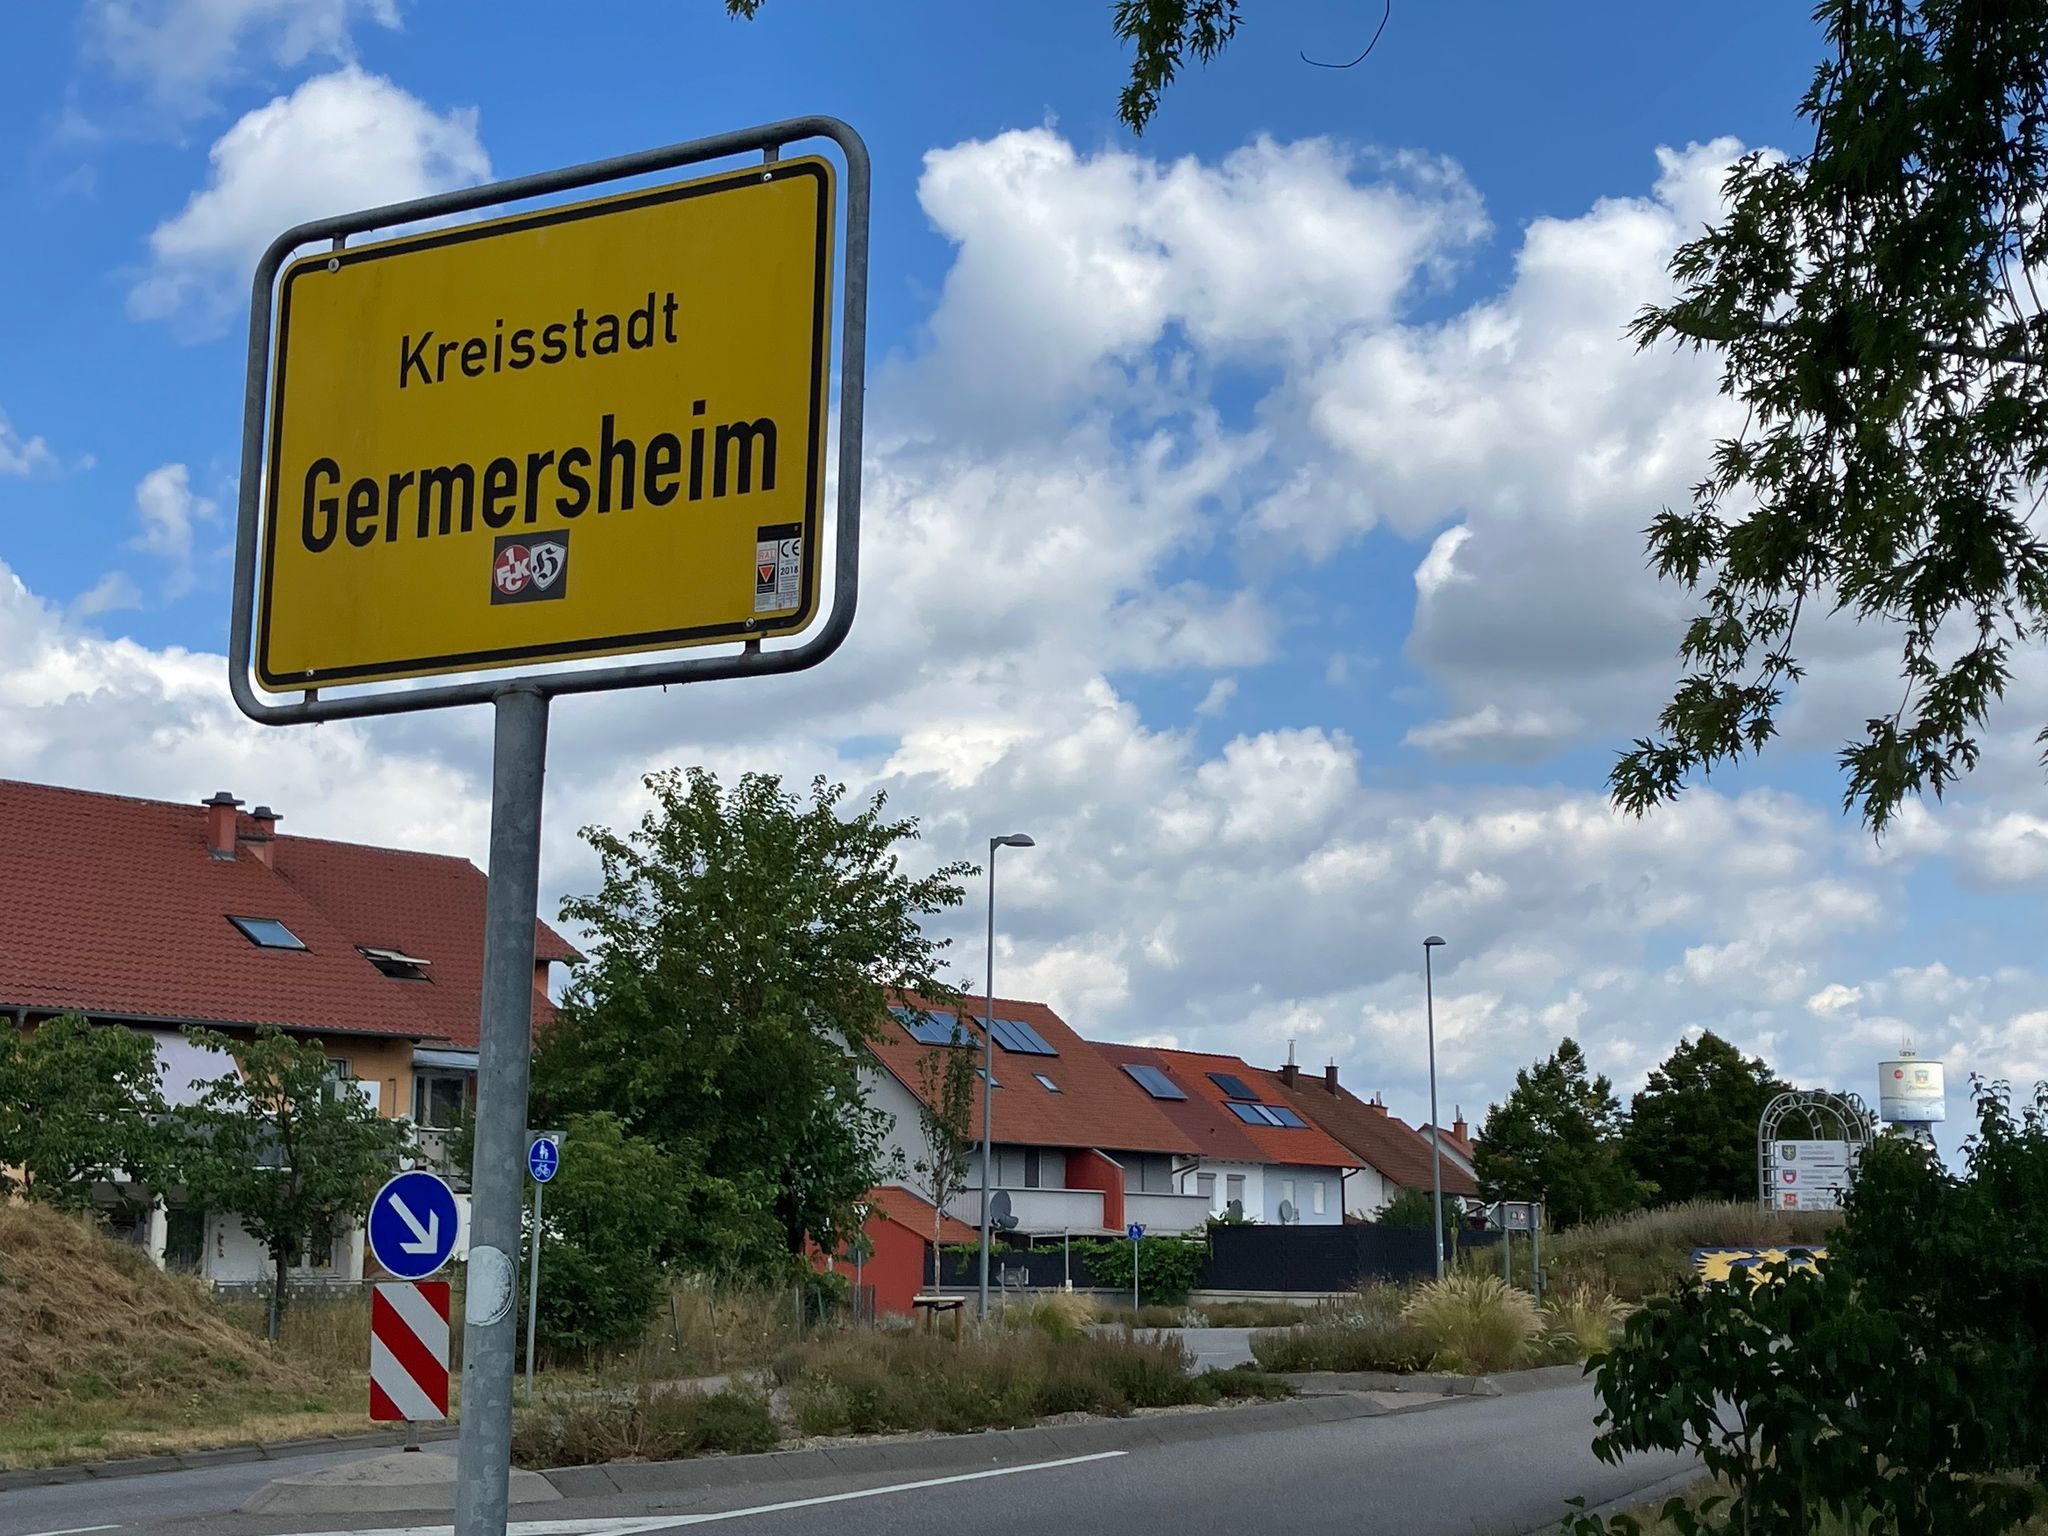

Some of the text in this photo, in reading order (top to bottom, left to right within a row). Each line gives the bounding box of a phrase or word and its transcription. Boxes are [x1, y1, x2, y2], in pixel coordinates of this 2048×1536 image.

[399, 291, 679, 389] Kreisstadt
[301, 399, 778, 553] Germersheim
[780, 565, 798, 576] 2018
[781, 539, 800, 558] CE
